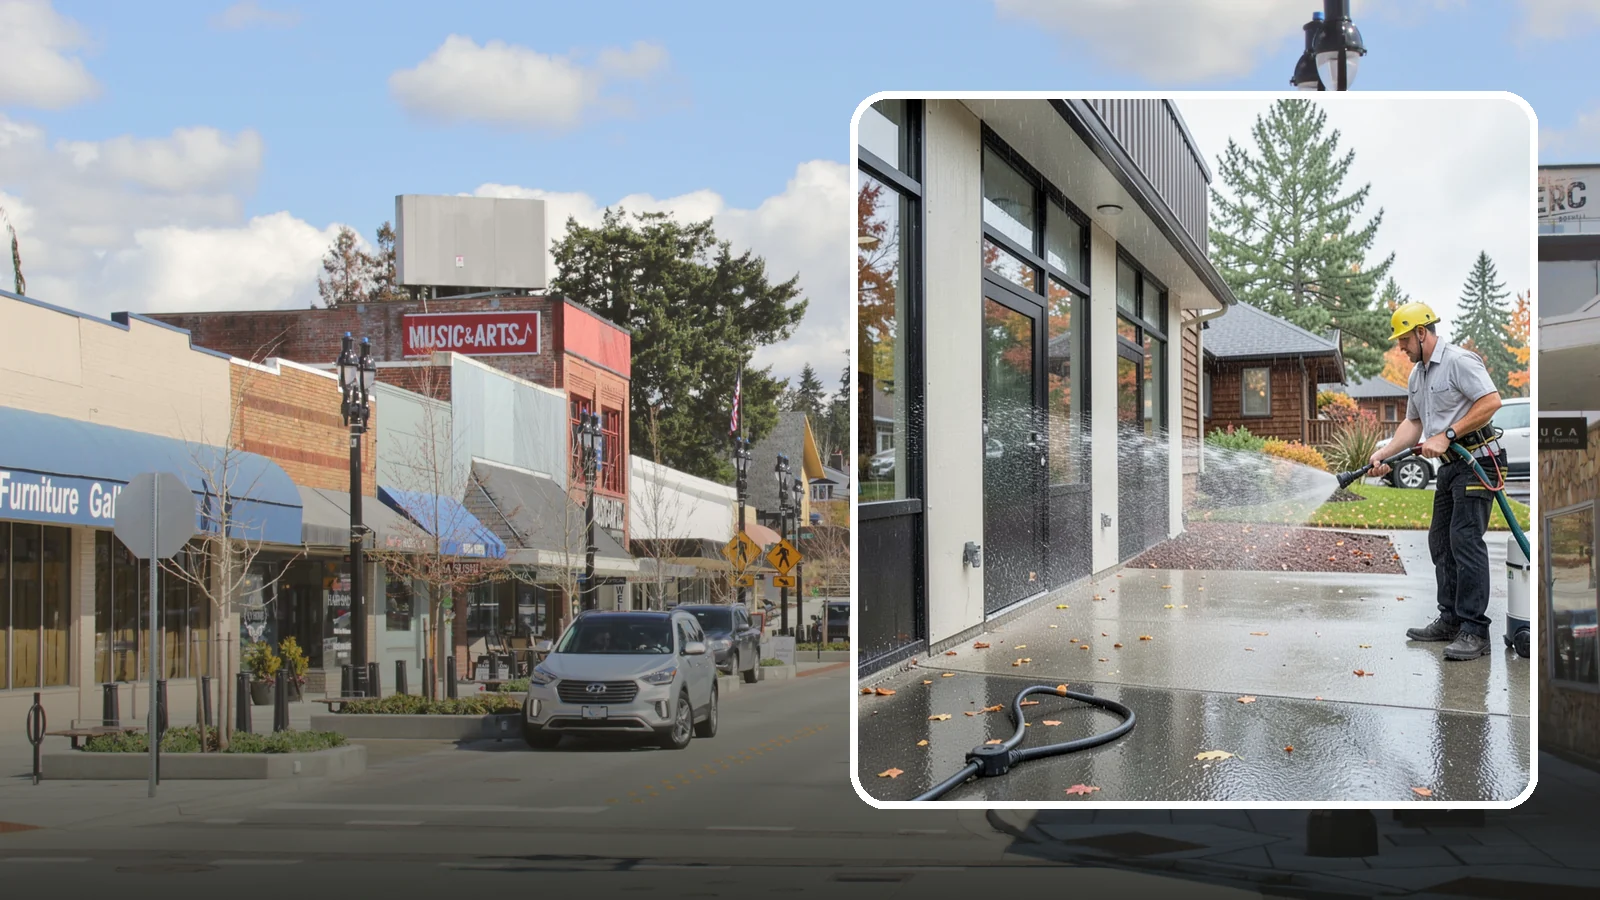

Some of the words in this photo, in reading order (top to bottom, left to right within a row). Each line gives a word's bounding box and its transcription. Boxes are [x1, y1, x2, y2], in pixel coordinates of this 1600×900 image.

[1540, 427, 1577, 436] UGA
[0, 471, 79, 515] Furniture
[89, 482, 122, 519] Gal
[453, 563, 480, 574] SUSHI
